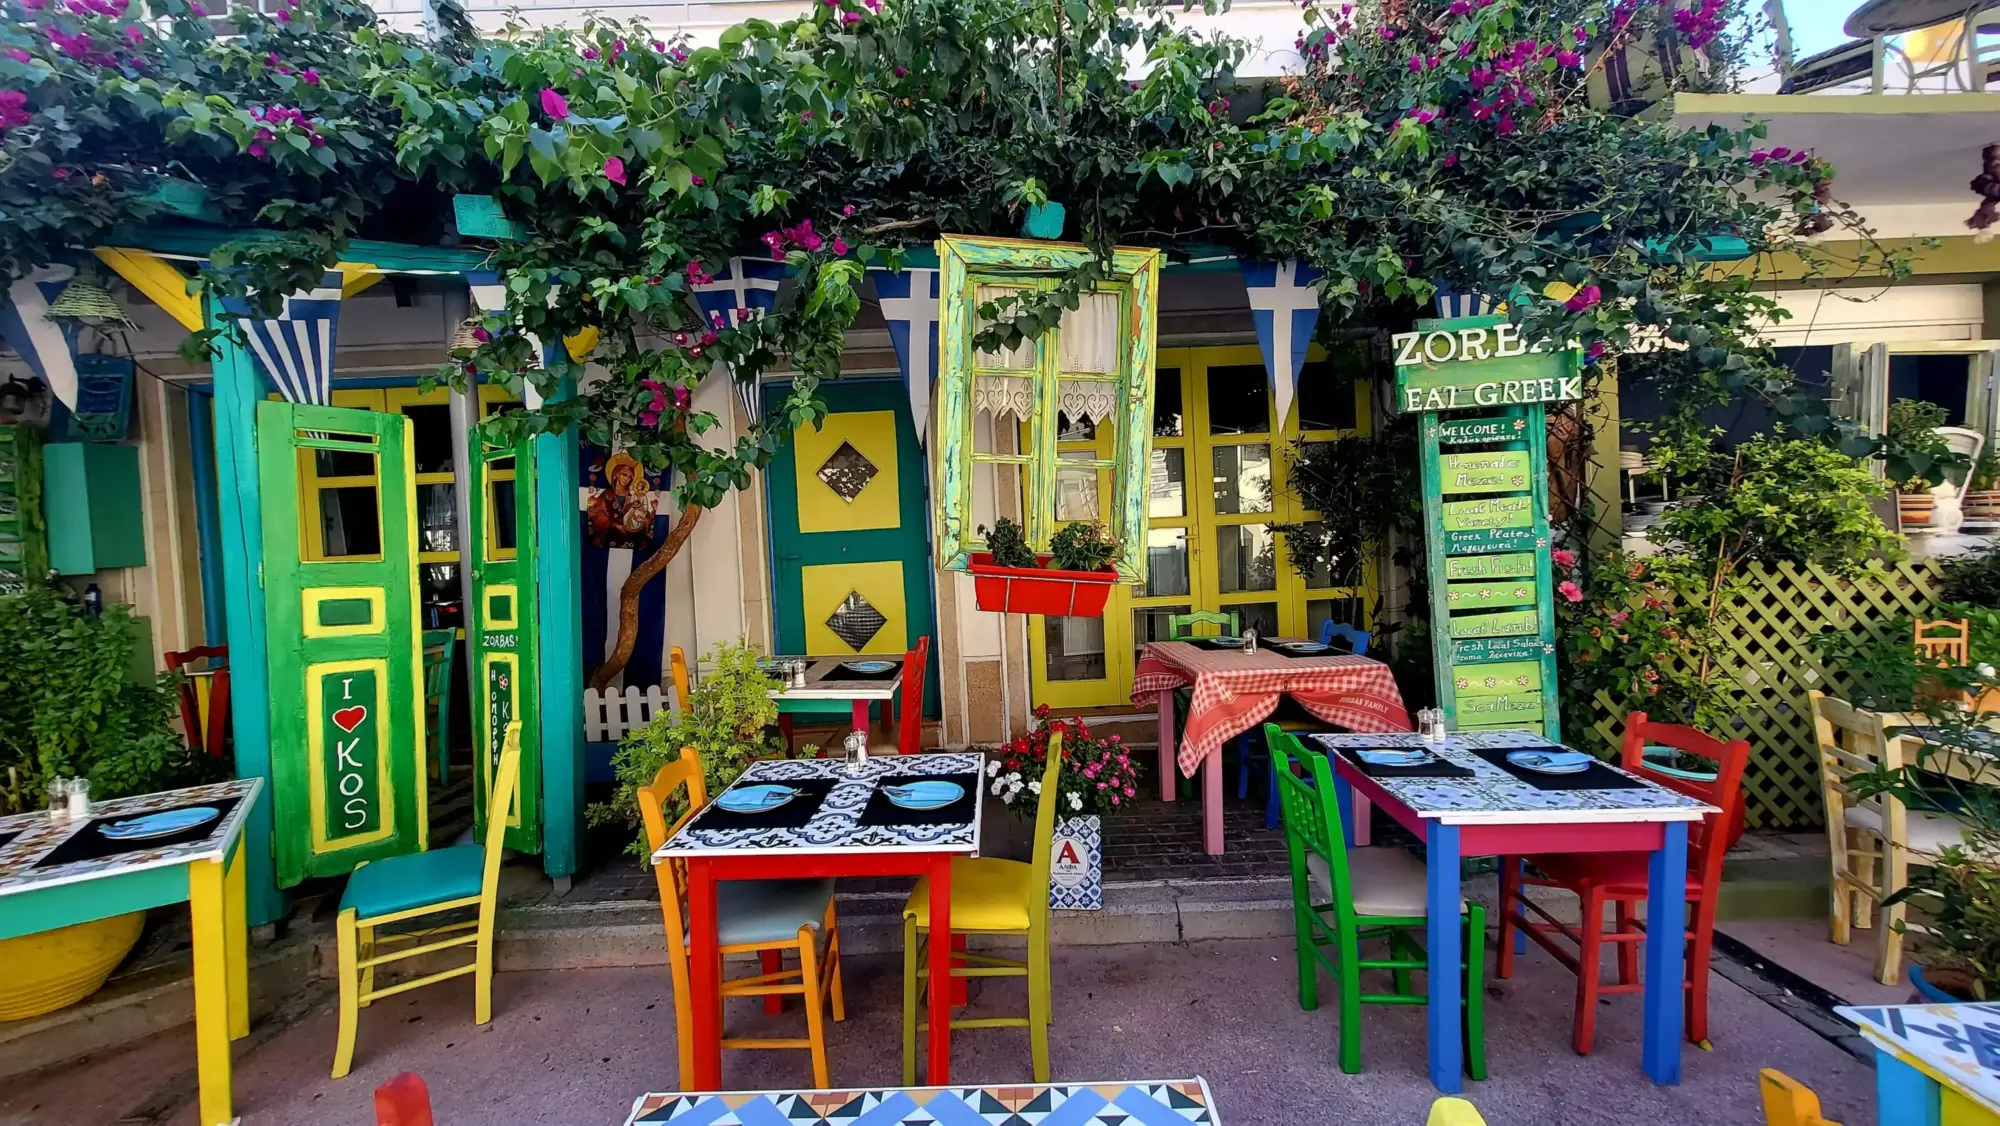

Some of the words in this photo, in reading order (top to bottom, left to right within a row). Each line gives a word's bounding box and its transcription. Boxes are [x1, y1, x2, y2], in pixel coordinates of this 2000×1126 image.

[1405, 386, 1458, 412] EAT
[1473, 375, 1583, 406] GREEK
[1455, 472, 1505, 487] Meze!
[1449, 501, 1485, 515] Local
[1449, 560, 1487, 577] Fresh
[1491, 555, 1533, 574] Fish!
[1452, 620, 1489, 636] Local
[1456, 639, 1484, 652] Fresh
[1487, 639, 1510, 650] Local
[342, 678, 353, 700] I
[1364, 700, 1389, 714] FAMILY
[337, 737, 368, 829] KOS
